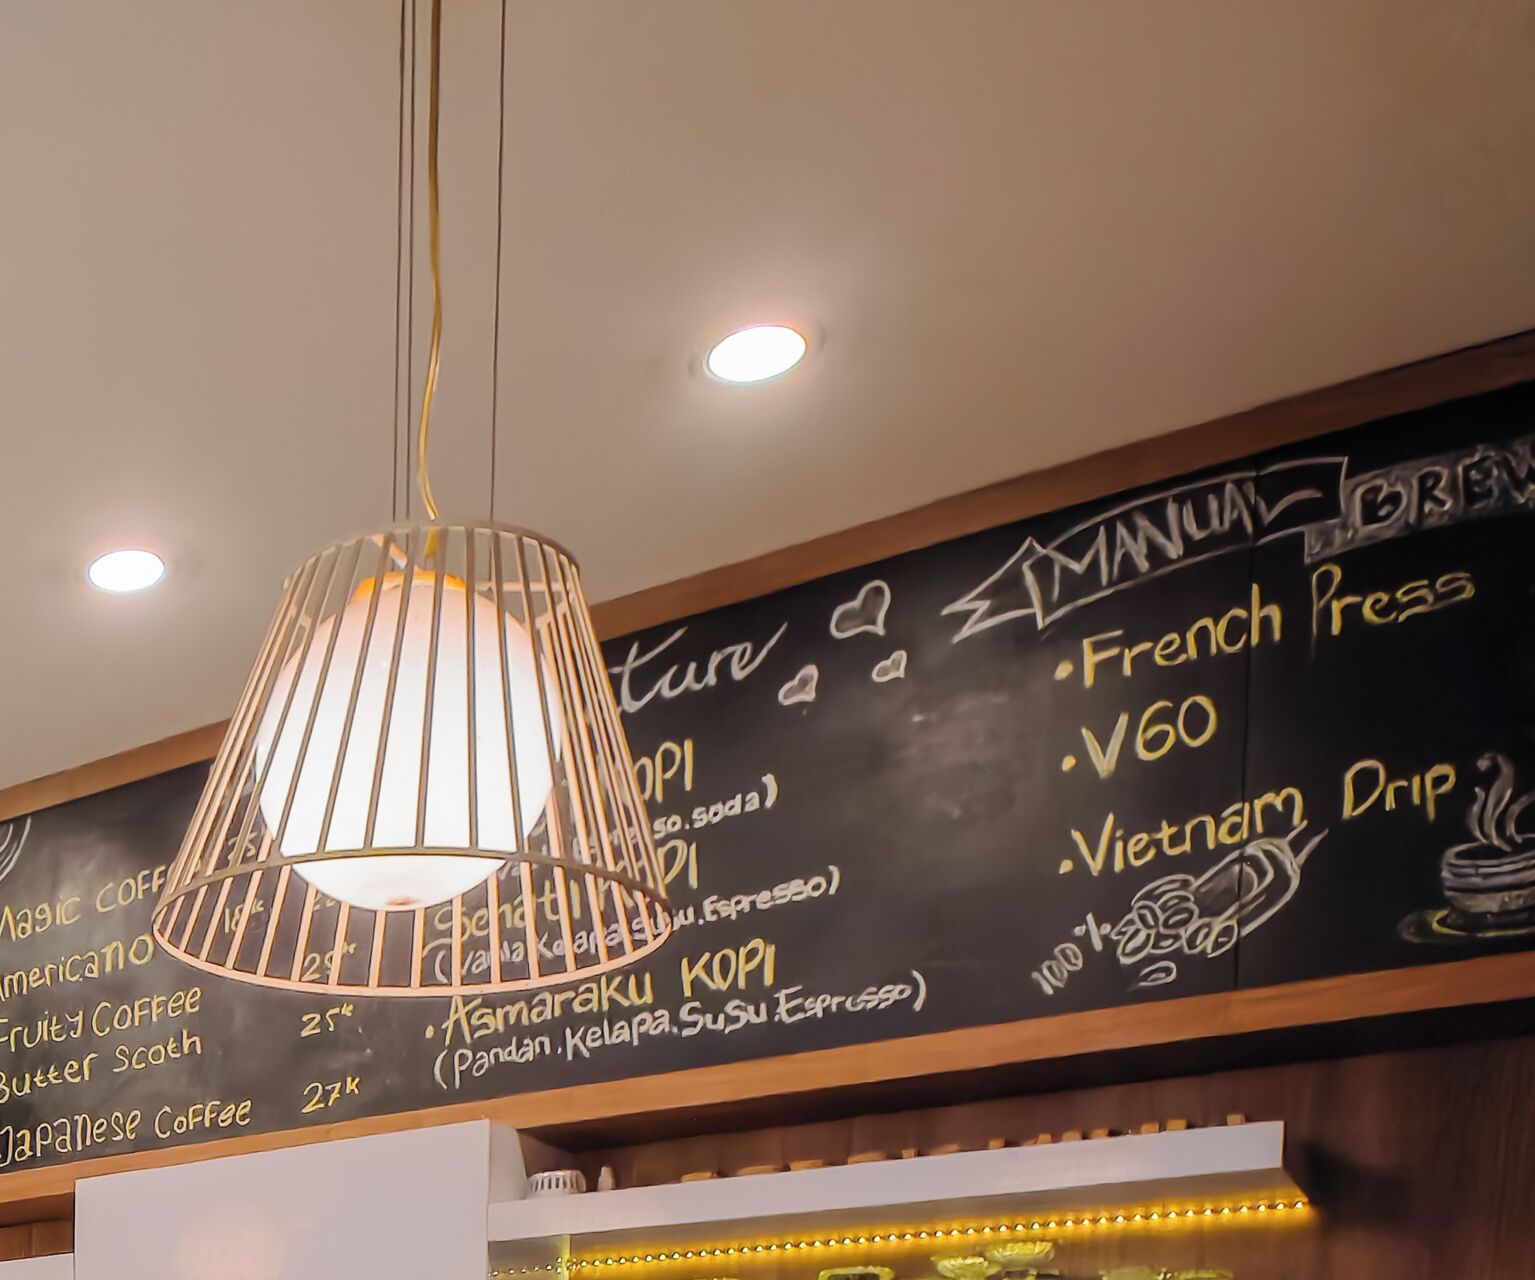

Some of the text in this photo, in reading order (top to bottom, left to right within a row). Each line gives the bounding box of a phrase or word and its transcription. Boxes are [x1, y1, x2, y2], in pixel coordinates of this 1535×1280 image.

[1084, 563, 1477, 688] French Press
[1081, 695, 1218, 779] V60
[1071, 786, 1304, 877] Vietnam
[444, 939, 777, 1047] Asmaraku KOPI
